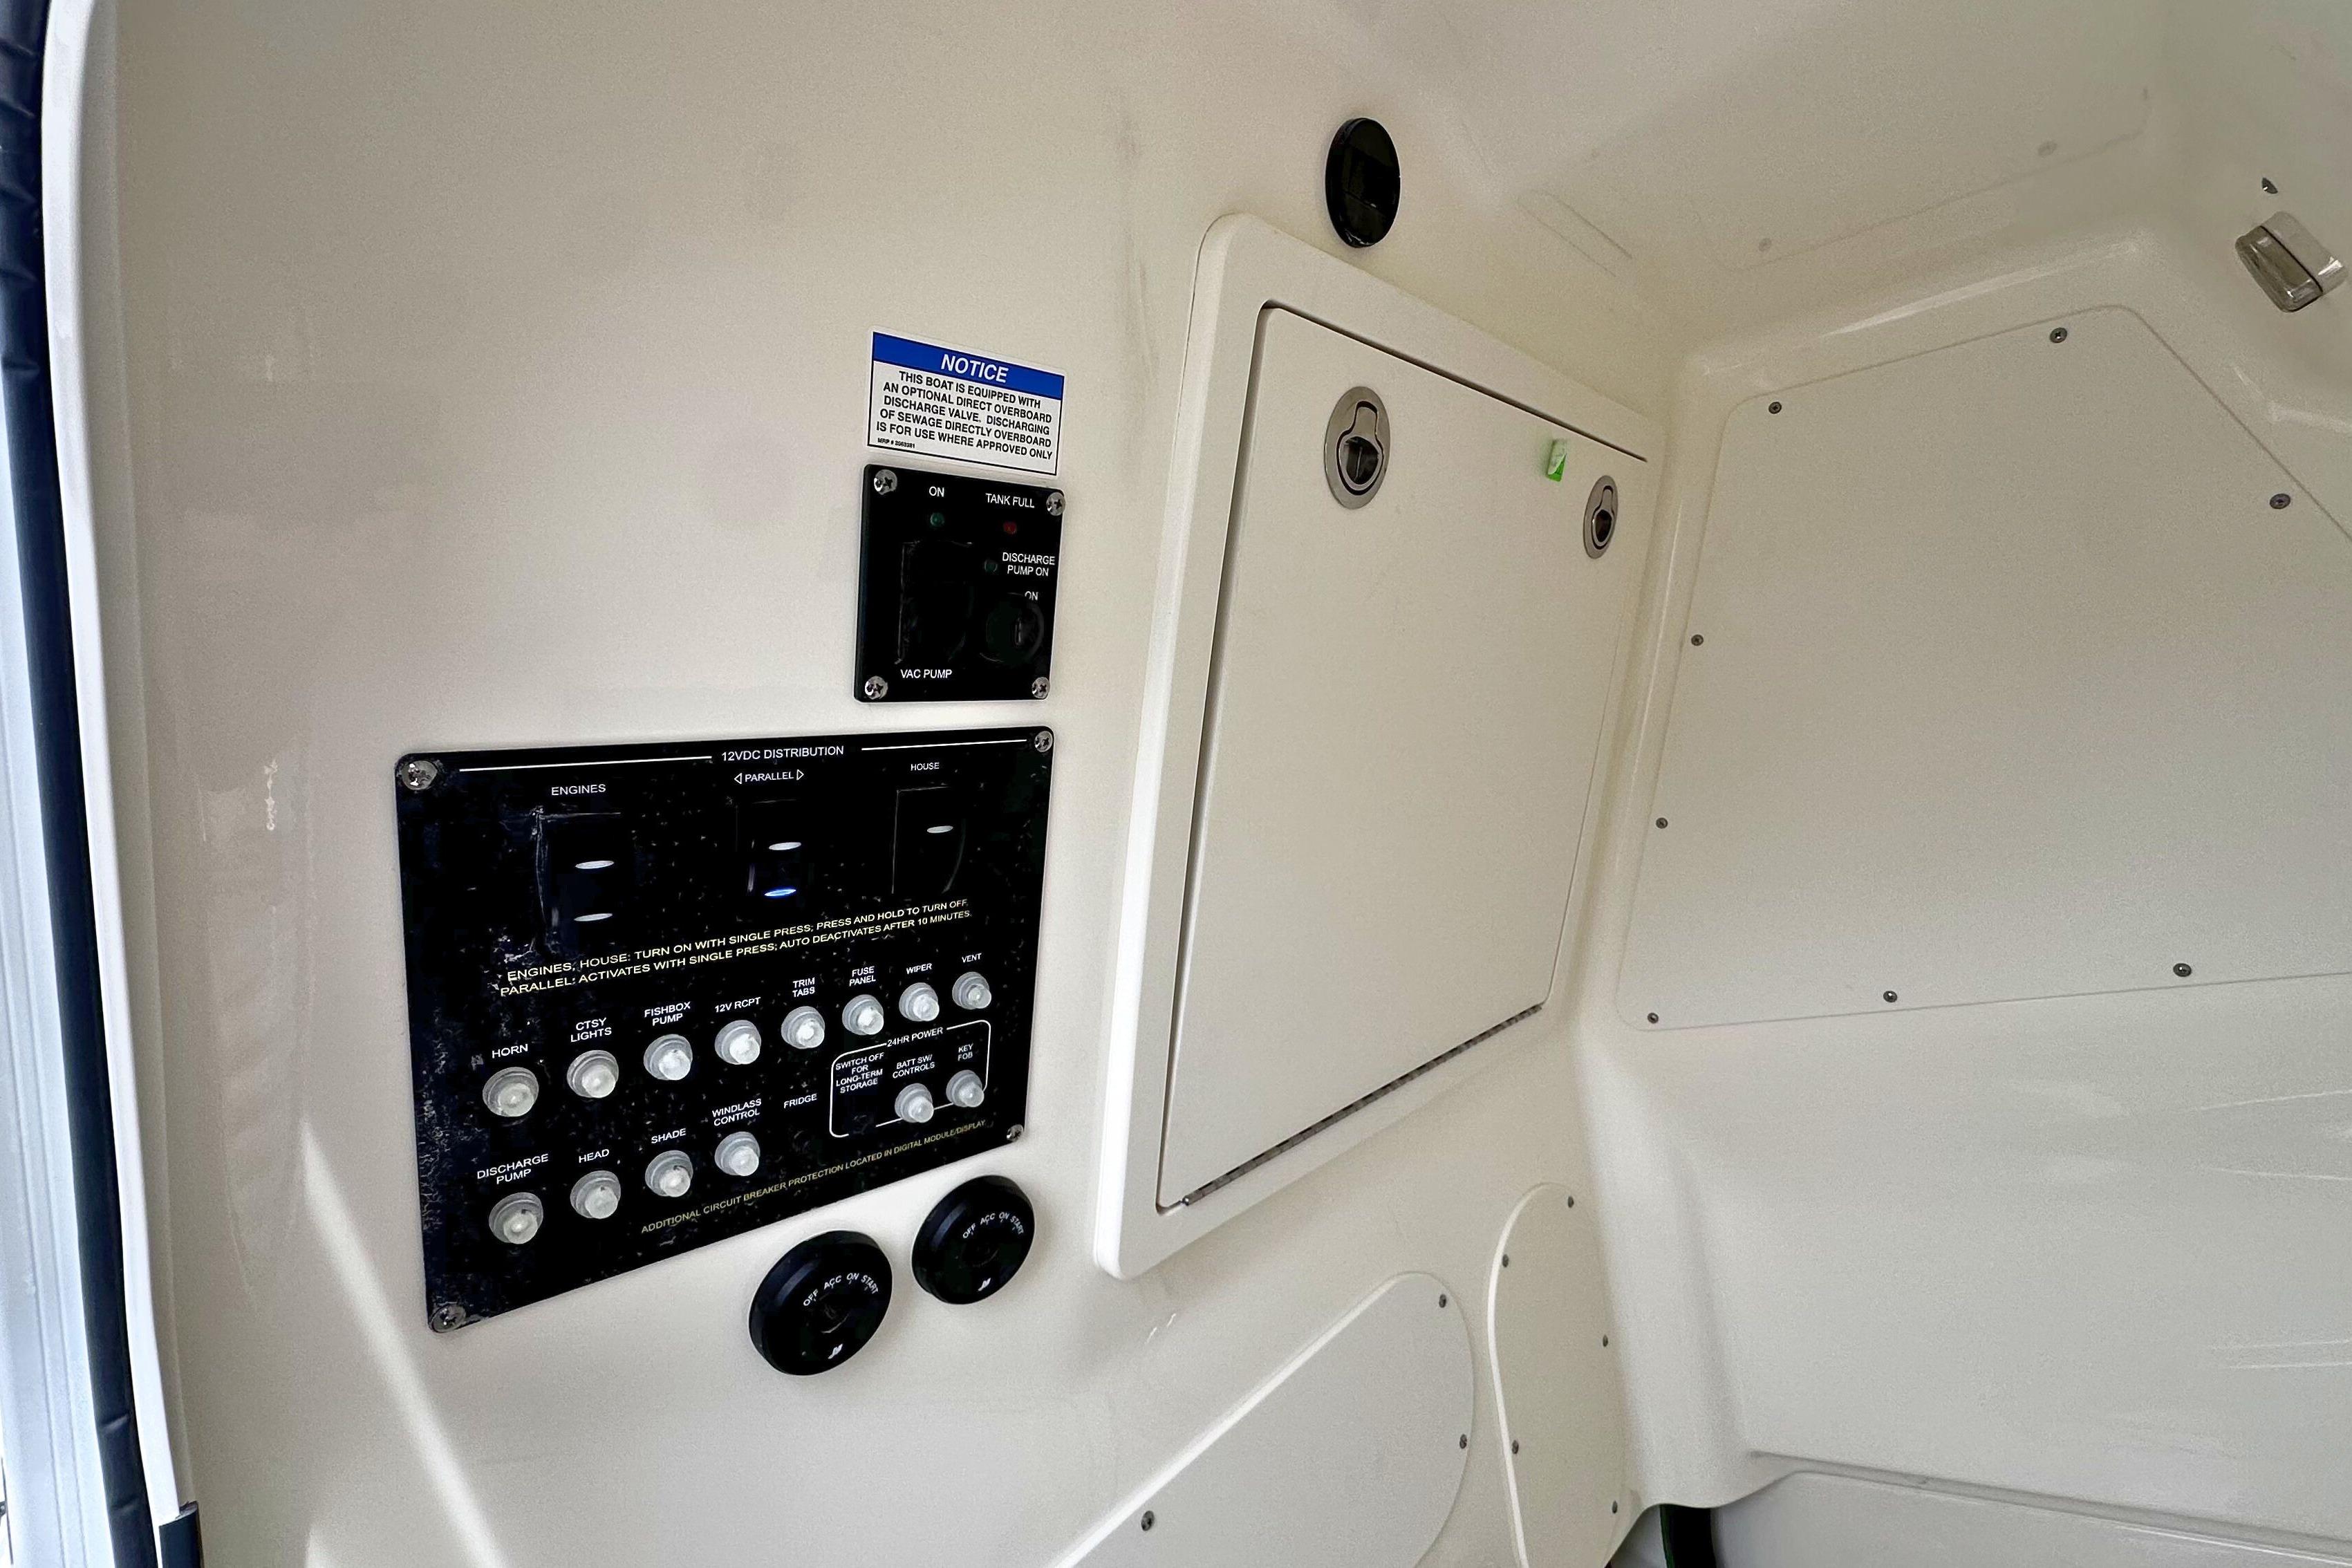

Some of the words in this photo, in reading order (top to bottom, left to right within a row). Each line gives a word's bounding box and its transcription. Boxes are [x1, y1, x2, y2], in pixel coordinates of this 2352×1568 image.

[941, 354, 1009, 383] NOTICE
[899, 371, 924, 384] THIS
[926, 376, 953, 391] BOAT
[956, 383, 965, 393] IS
[968, 385, 1016, 404] EQUIPPED
[1018, 395, 1040, 409] WITH
[884, 382, 899, 393] AN
[902, 386, 953, 404] OPTIONAL
[957, 397, 991, 411] DIRECT
[994, 404, 1052, 423] OVERBOARD
[884, 395, 945, 416] DISCHARGE
[948, 408, 981, 422] VALVE.
[987, 415, 1049, 436] DISCHARGING
[880, 409, 895, 419] OF
[897, 412, 942, 428] SEWAGE
[945, 420, 991, 437] DIRECTLY
[994, 429, 1051, 447] OVERBOARD
[877, 421, 886, 431] IS
[890, 424, 911, 436] FOR
[915, 428, 935, 440] USE
[937, 431, 973, 447] WHERE
[976, 439, 1027, 456] APPROVED
[1029, 447, 1052, 460] ONLY
[929, 487, 944, 497] ON
[986, 493, 1010, 505] TANK
[1013, 497, 1034, 508] FULL
[1002, 552, 1055, 565] DISCHARGE
[1007, 566, 1033, 575] PUMP
[1036, 567, 1049, 577] ON
[1025, 591, 1038, 600] ON
[900, 669, 921, 678] VAC
[924, 669, 953, 678] PUMP
[722, 750, 760, 761] 12VDC
[764, 746, 844, 759] DISTRIBUTION
[911, 763, 939, 771] HOUSE
[745, 772, 794, 782] PARALLEL
[552, 784, 606, 795] ENGINES
[507, 963, 575, 981] ENGINES,
[580, 953, 631, 968] HOUSE:
[634, 948, 670, 960] TURN
[673, 944, 691, 953] ON
[696, 937, 725, 950] WITH
[729, 931, 770, 944] SINGLE
[774, 924, 814, 937] PRESS;
[816, 918, 851, 931] PRESS
[854, 915, 875, 924] AND
[877, 910, 904, 920] HOLD
[922, 903, 947, 913] TURN
[501, 978, 575, 996] PARALLEL:
[579, 964, 650, 983] ACTIVATES
[653, 958, 686, 970] WITH
[689, 950, 732, 964] SINGLE
[736, 942, 778, 957] PRESS;
[780, 937, 810, 950] AUTO
[813, 925, 881, 944] DEACTIVATES
[883, 920, 915, 931] AFTER
[930, 910, 972, 923] MINUTES.
[962, 953, 982, 962] VENT
[852, 967, 875, 977] FUSE
[906, 963, 932, 974] WIPER
[793, 978, 815, 989] TRIM
[849, 976, 875, 987] PANEL
[793, 987, 815, 997] TABS
[644, 1001, 691, 1018] FISHBOX
[714, 1002, 732, 1013] 12V
[734, 997, 760, 1009] RCPT
[576, 1018, 606, 1031] CTSY
[653, 1014, 683, 1026] PUMP
[570, 1027, 612, 1043] LIGHTS
[887, 1036, 910, 1047] 24HR
[912, 1027, 943, 1040] POWER
[492, 1044, 528, 1058] HORN
[958, 1043, 973, 1053] KEY
[836, 1057, 867, 1070] SWITCH
[869, 1052, 884, 1061] OFF
[897, 1058, 914, 1070] BATT
[958, 1052, 973, 1061] FOB
[852, 1065, 868, 1074] FOR
[893, 1062, 935, 1079] CONTROLS
[836, 1069, 883, 1087] LONG-TERM
[840, 1079, 878, 1094] STORAGE
[712, 1099, 761, 1117] WINDLASS
[784, 1093, 817, 1109] FRIDGE
[714, 1108, 760, 1126] CONTROL
[651, 1128, 686, 1144] SHADE
[579, 1149, 610, 1163] HEAD
[477, 1153, 548, 1179] DISCHARGE
[496, 1169, 531, 1184] PUMP
[642, 1208, 701, 1233] ADDITIONAL
[704, 1196, 741, 1214] CIRCUIT
[744, 1182, 786, 1201] BREAKER
[788, 1164, 843, 1187] PROTECTION
[846, 1152, 882, 1169] LOCATED
[894, 1139, 922, 1155] DIGITAL
[924, 1120, 986, 1145] MODULE/DISPLAY
[962, 1223, 976, 1239] OFF
[980, 1213, 996, 1225] ACC
[1010, 1215, 1024, 1235] START
[803, 1289, 819, 1307] OFF
[824, 1276, 842, 1290] ACC
[861, 1275, 878, 1294] START
